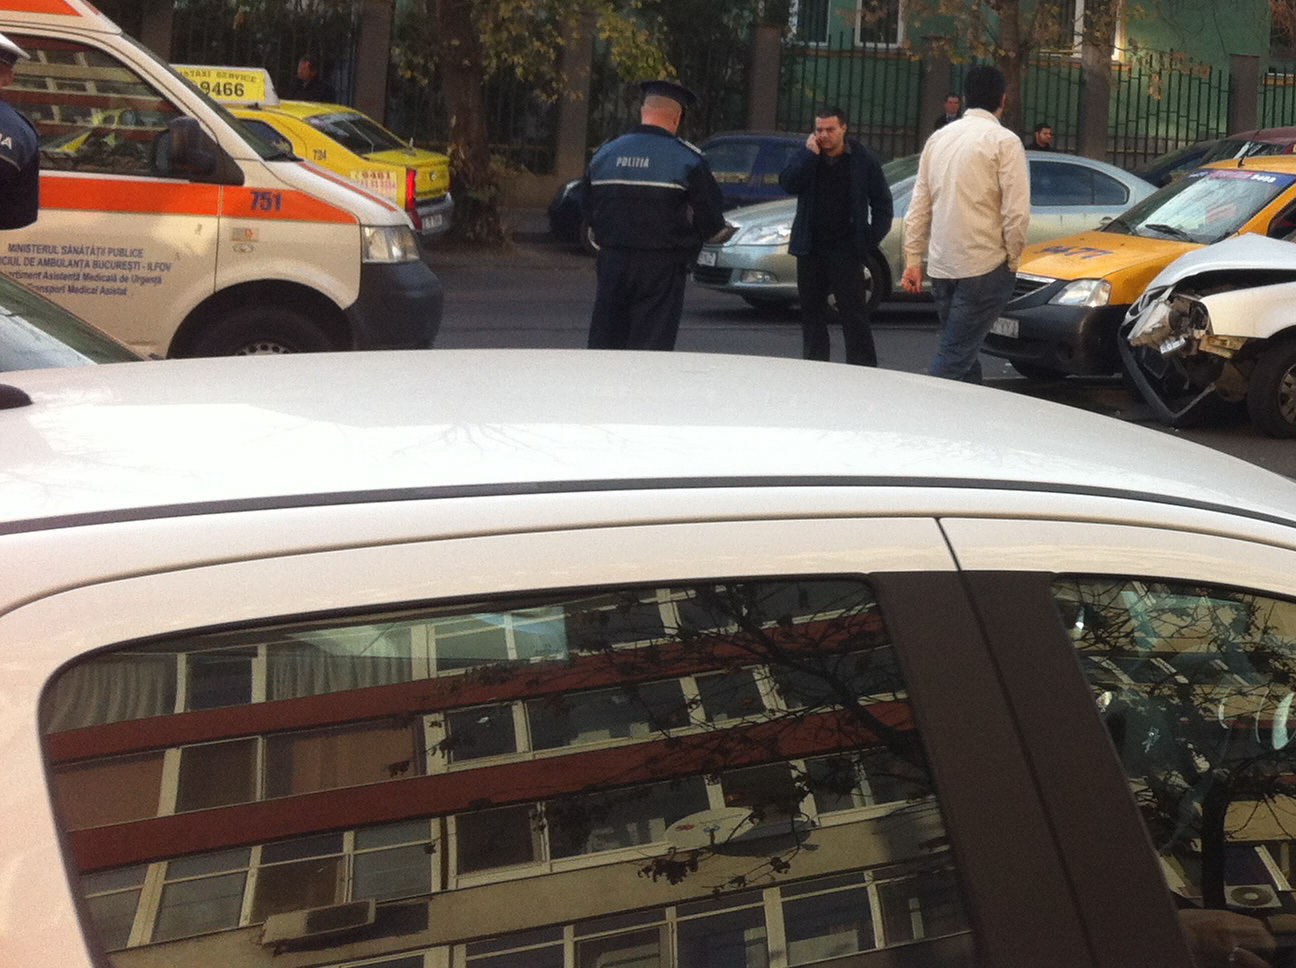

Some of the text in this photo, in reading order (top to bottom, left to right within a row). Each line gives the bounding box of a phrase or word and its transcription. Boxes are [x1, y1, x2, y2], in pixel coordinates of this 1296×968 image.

[216, 71, 257, 83] SERVICE
[250, 190, 282, 211] 751
[8, 243, 60, 254] MINISTERUL
[107, 247, 145, 259] PUBLICE
[23, 257, 36, 267] DE
